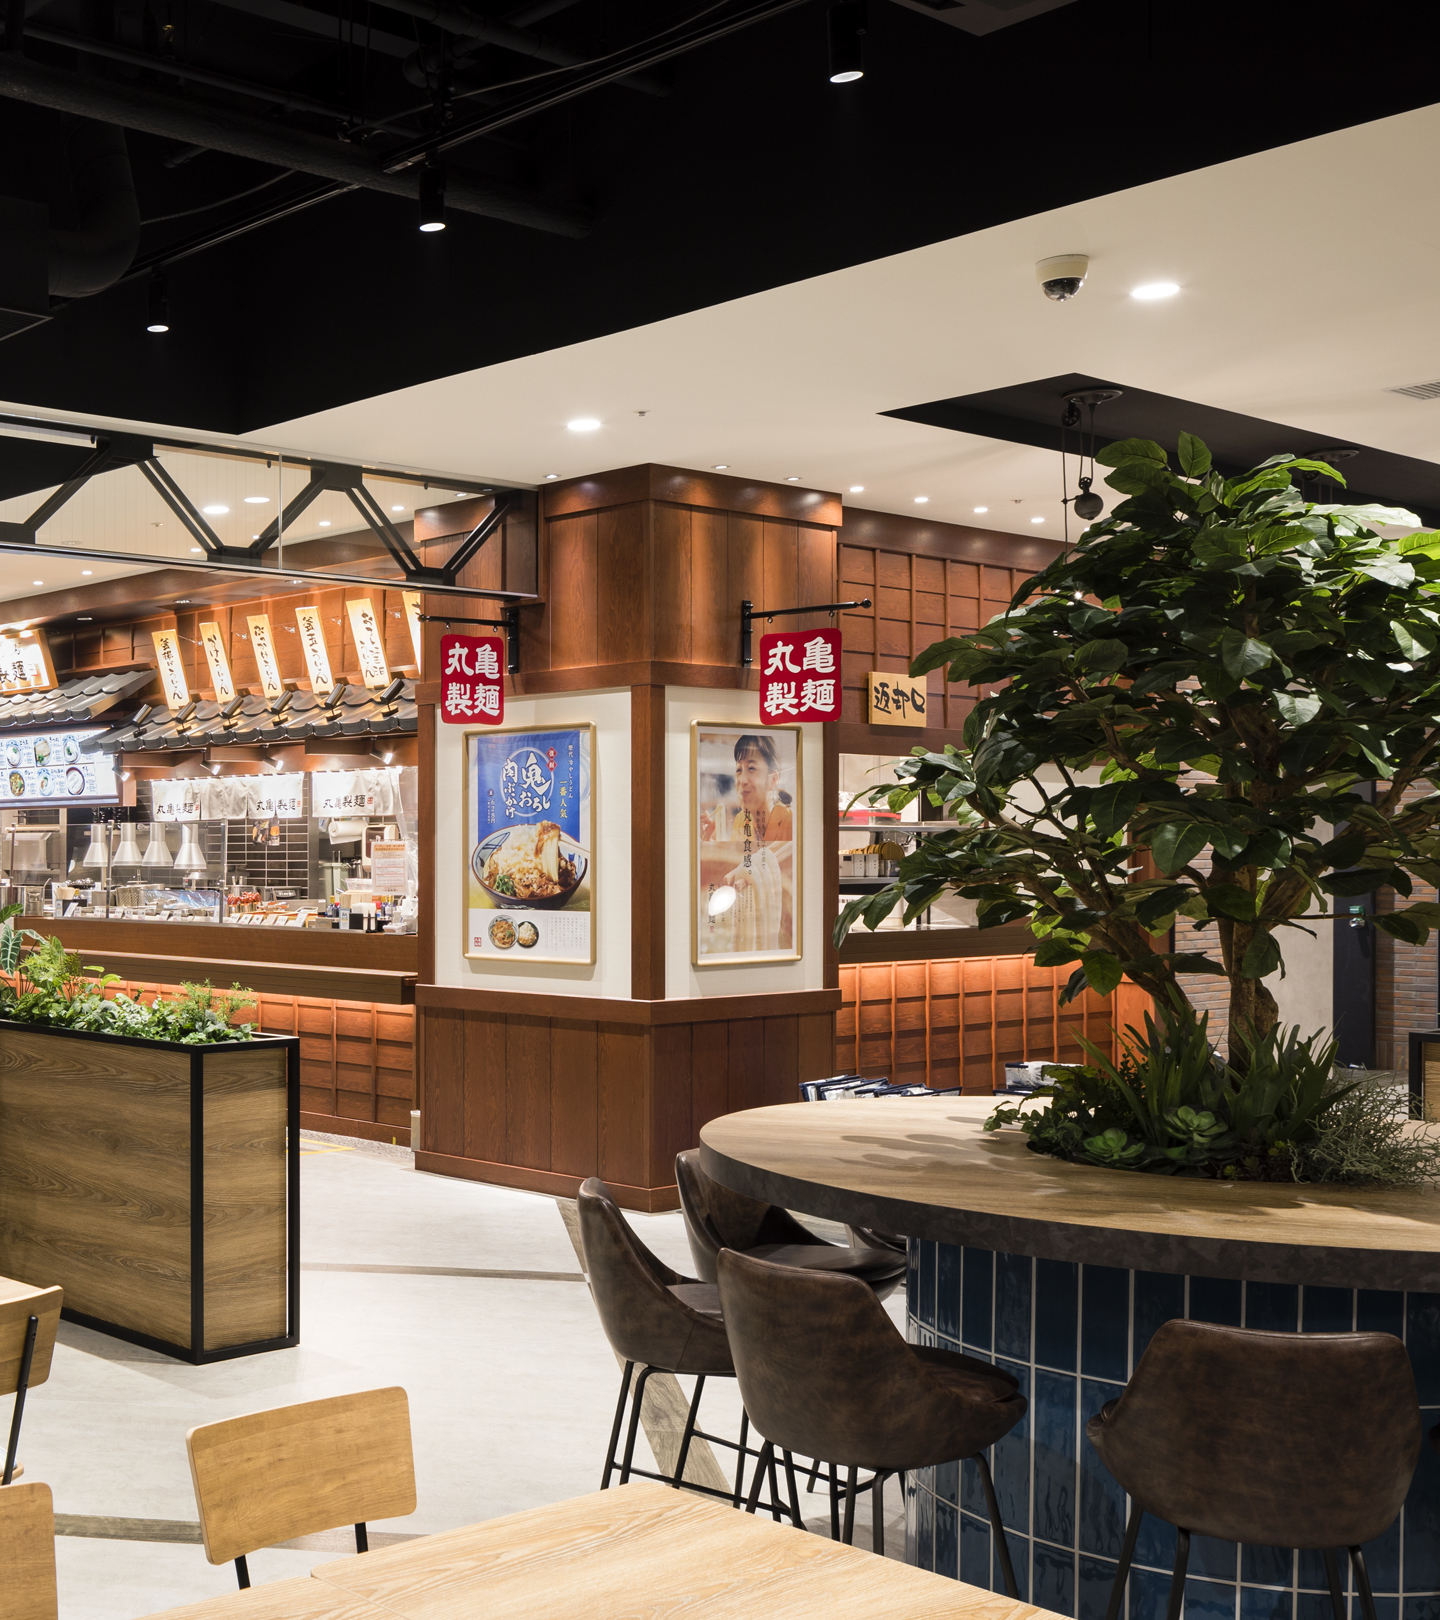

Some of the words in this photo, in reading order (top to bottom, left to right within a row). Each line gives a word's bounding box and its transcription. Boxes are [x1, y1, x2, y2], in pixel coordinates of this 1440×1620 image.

[159, 637, 184, 701] 釜揚げうどん
[206, 633, 230, 695] かけうどん
[253, 625, 278, 691] ぶっかけうどん
[302, 616, 329, 685] 釜玉うどん
[444, 641, 500, 680] 丸亀
[763, 636, 836, 676] 丸亀
[444, 681, 500, 717] 製麺
[763, 678, 836, 717] 製麺
[873, 680, 926, 719] 返却口
[519, 751, 552, 813] 鬼おろし
[708, 883, 717, 924] 丸麺
